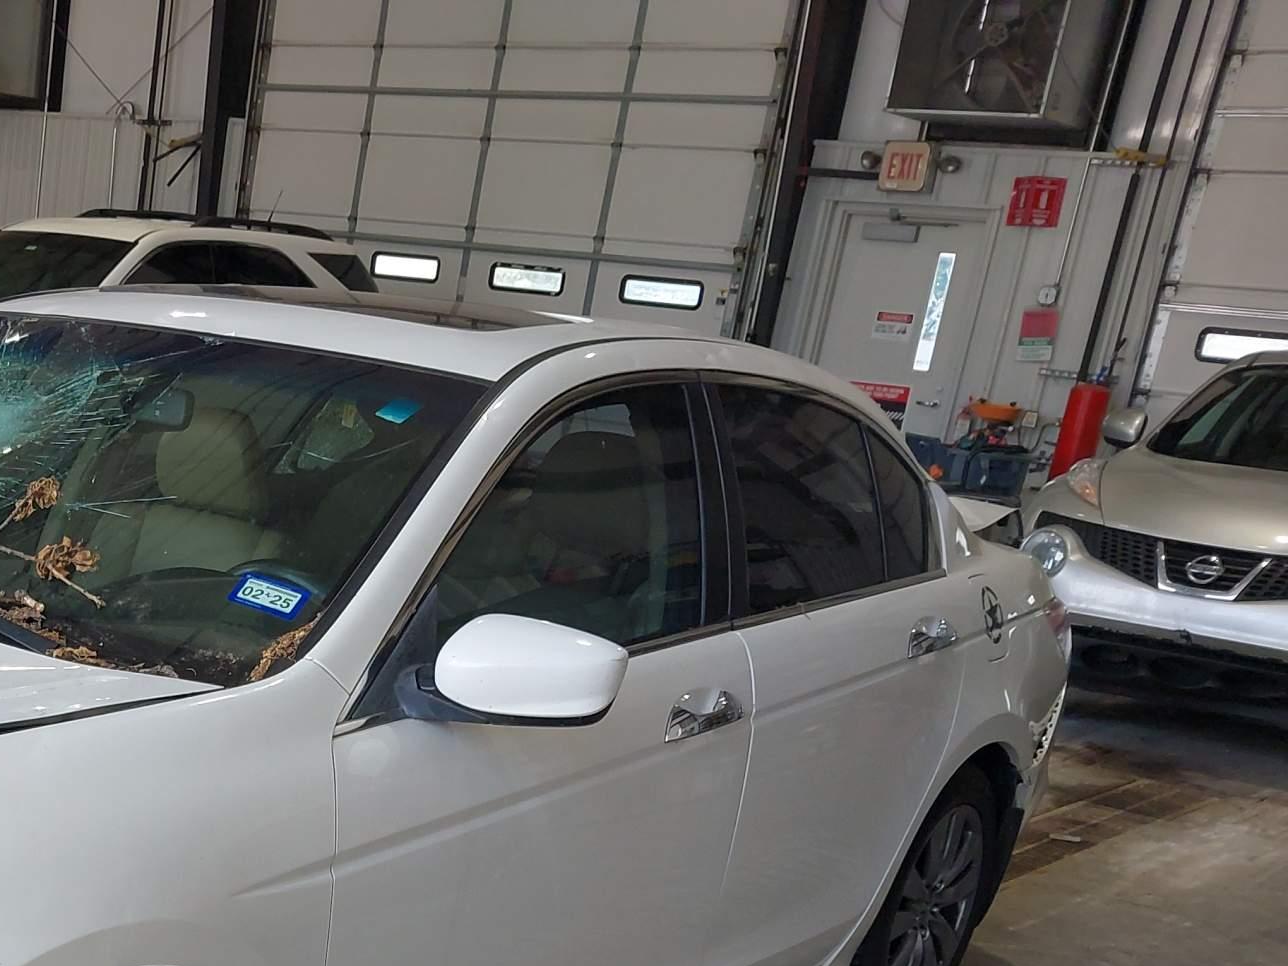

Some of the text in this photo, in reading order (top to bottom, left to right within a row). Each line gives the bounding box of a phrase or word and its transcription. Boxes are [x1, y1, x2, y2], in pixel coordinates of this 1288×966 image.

[888, 152, 924, 180] EXIT
[241, 585, 265, 600] 02
[269, 595, 294, 610] 25
